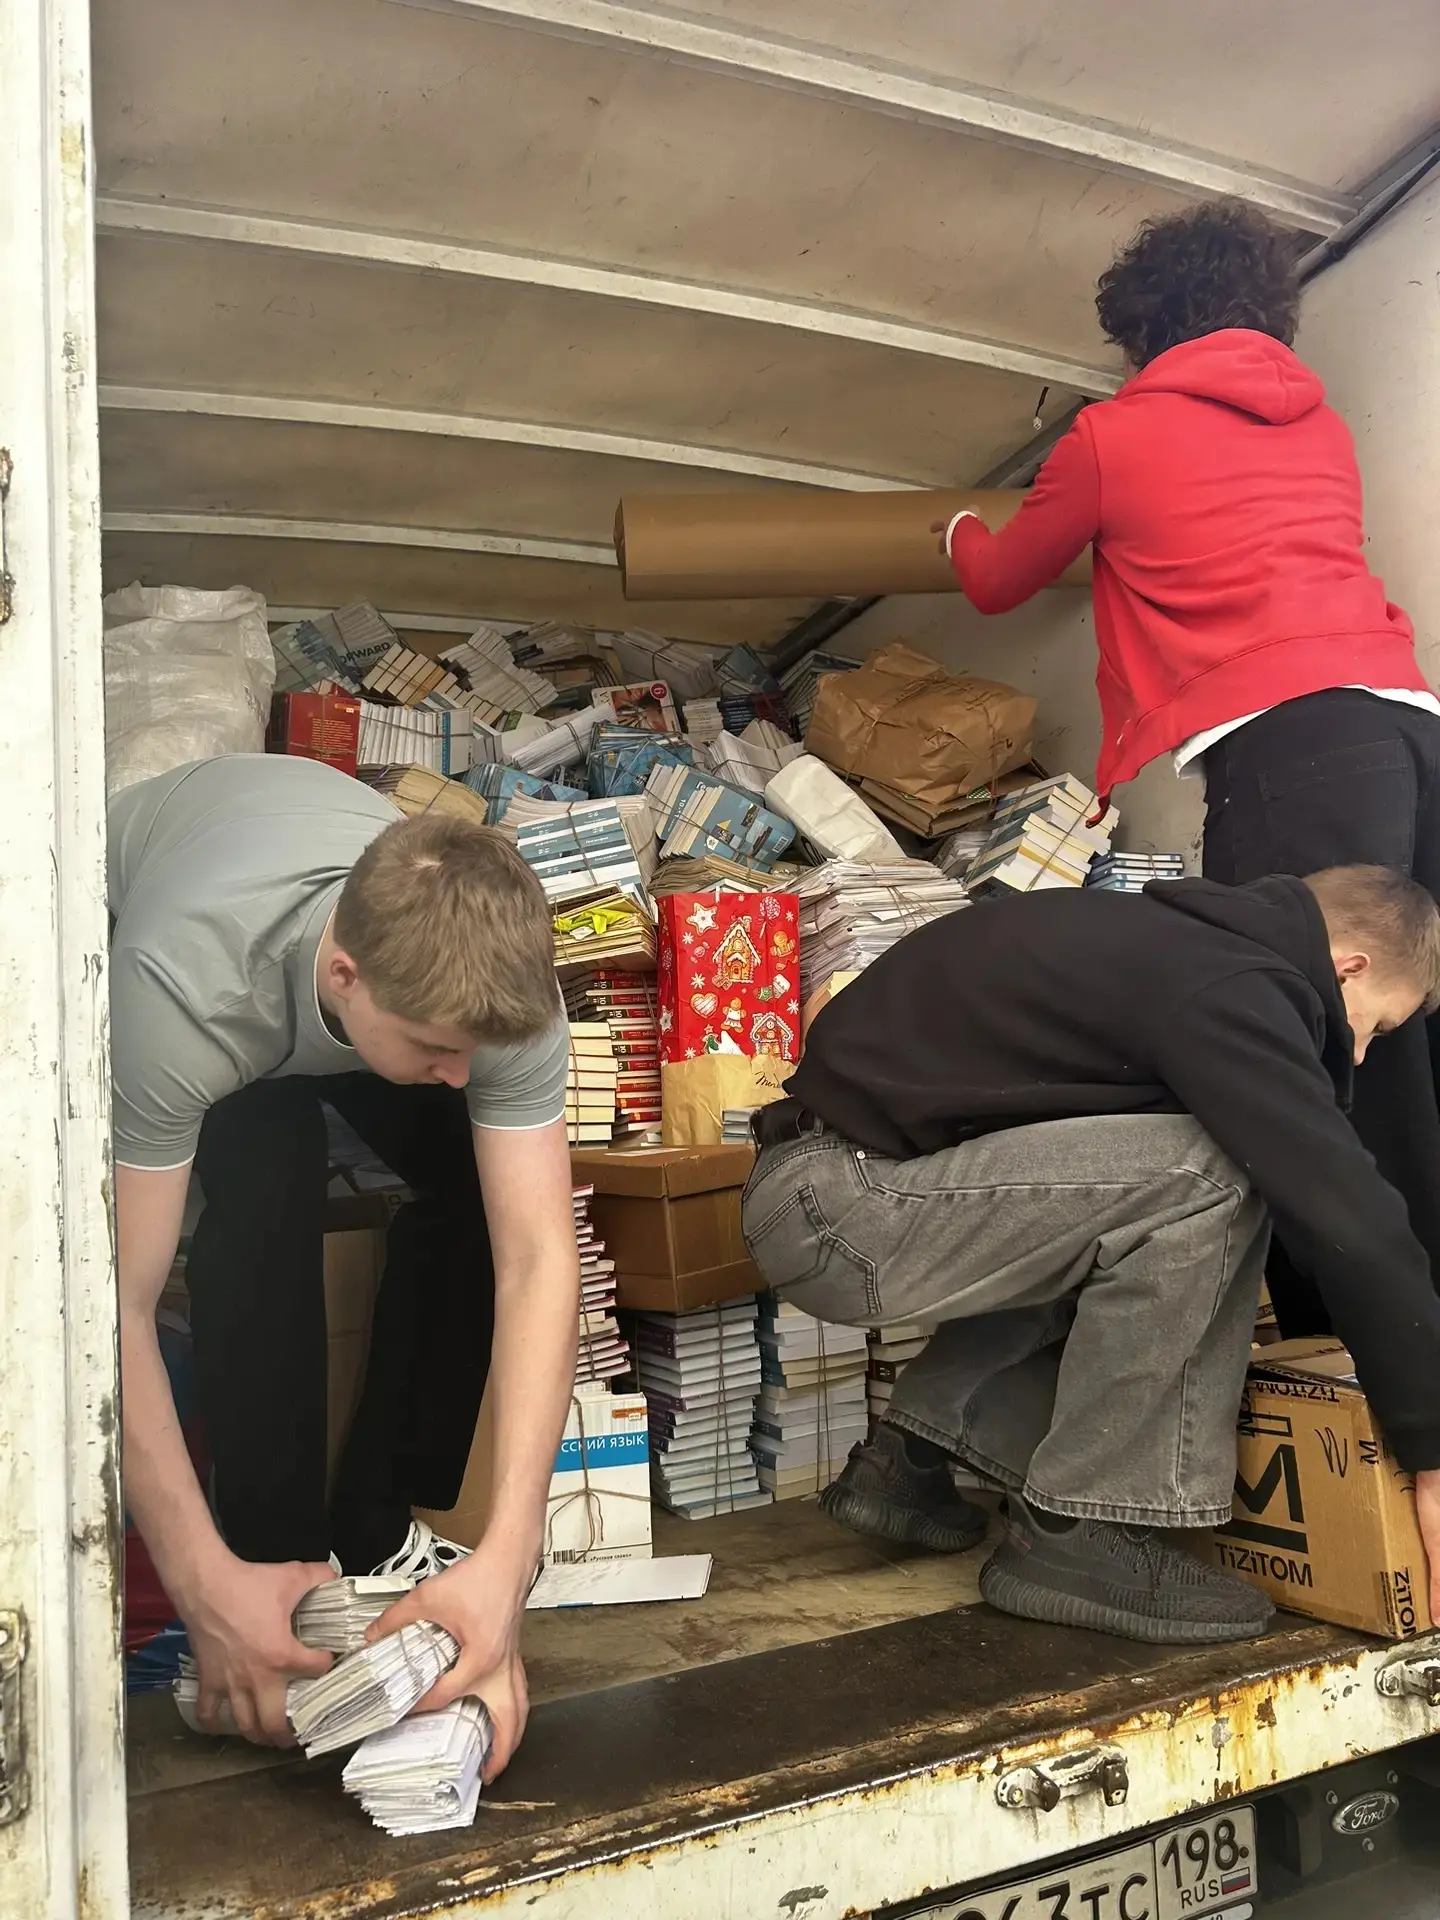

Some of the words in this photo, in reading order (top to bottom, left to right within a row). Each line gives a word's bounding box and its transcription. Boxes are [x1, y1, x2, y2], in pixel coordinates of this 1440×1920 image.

[610, 1434, 645, 1448] ЯЗЫК
[1215, 1542, 1313, 1588] TiZiTOM
[1351, 1801, 1388, 1828] Ford
[1161, 1818, 1239, 1889] 198
[1181, 1879, 1219, 1909] RUS
